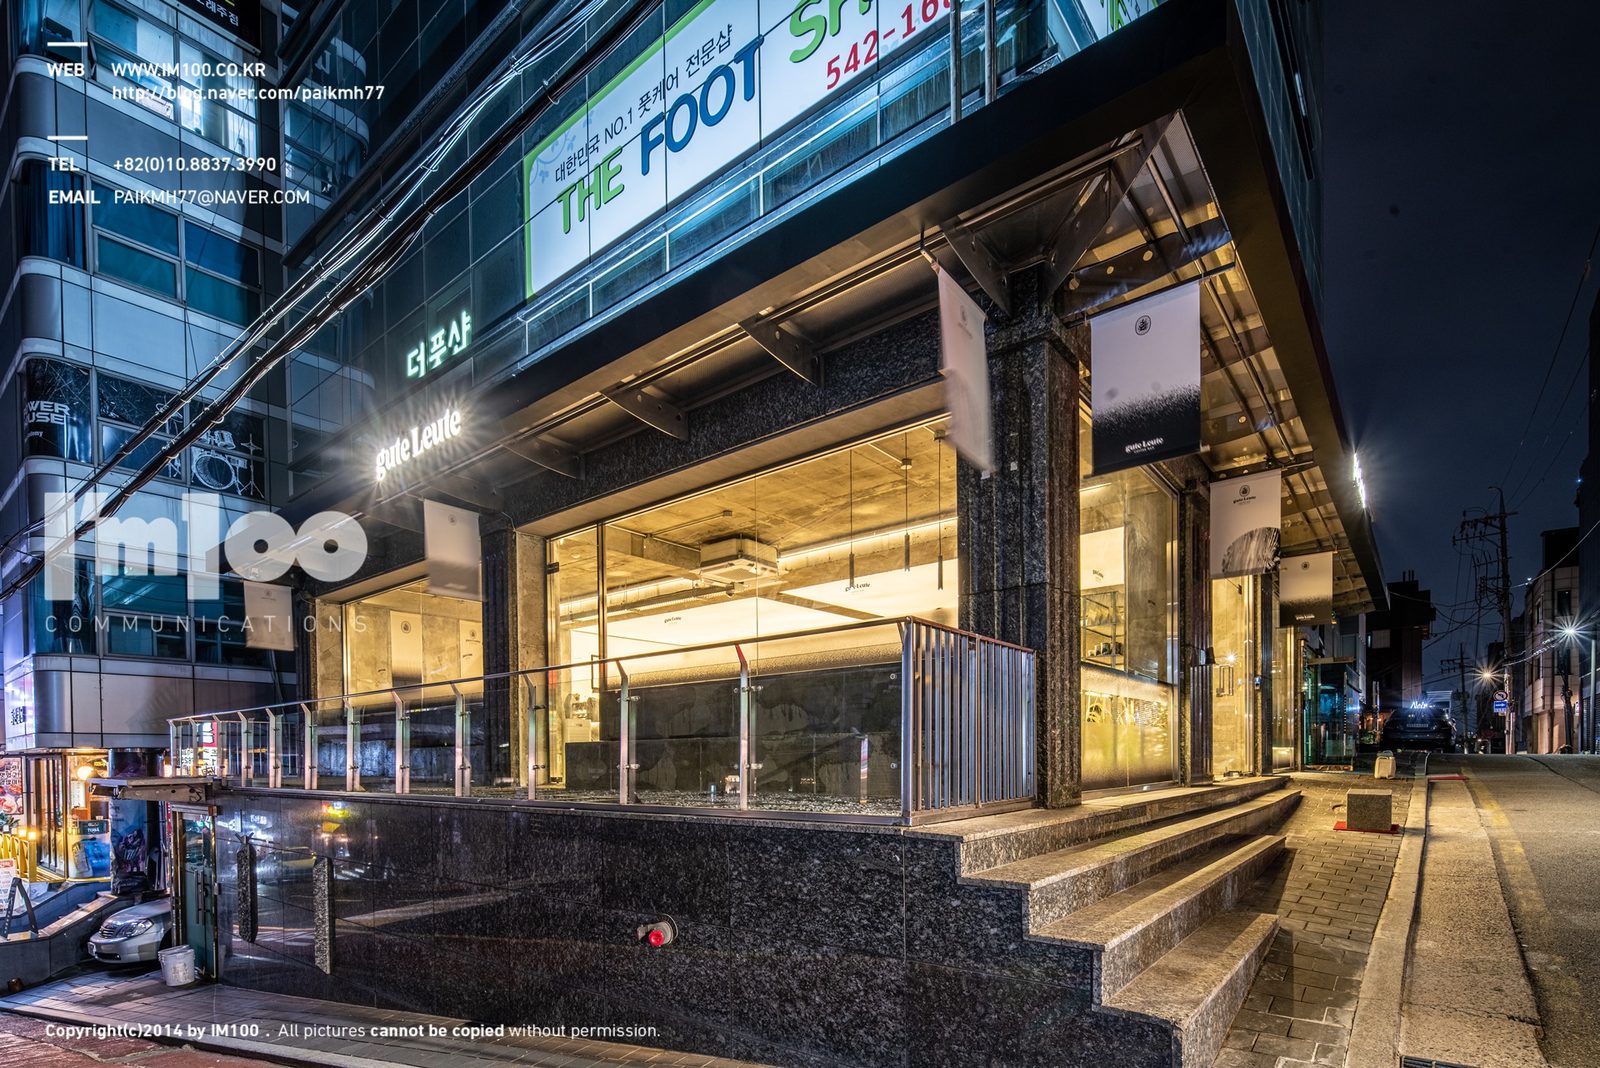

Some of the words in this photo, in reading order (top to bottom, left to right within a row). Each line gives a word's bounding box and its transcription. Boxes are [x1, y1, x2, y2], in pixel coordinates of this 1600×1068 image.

[555, 134, 600, 183] 대한민국
[604, 107, 633, 144] NO.1
[638, 67, 679, 118] 풋케어
[685, 24, 733, 79] 전문샵
[825, 0, 950, 91] 542-16
[556, 145, 625, 234] THE
[640, 34, 764, 176] FOOT
[375, 436, 411, 482] gute
[410, 408, 462, 459] Leute
